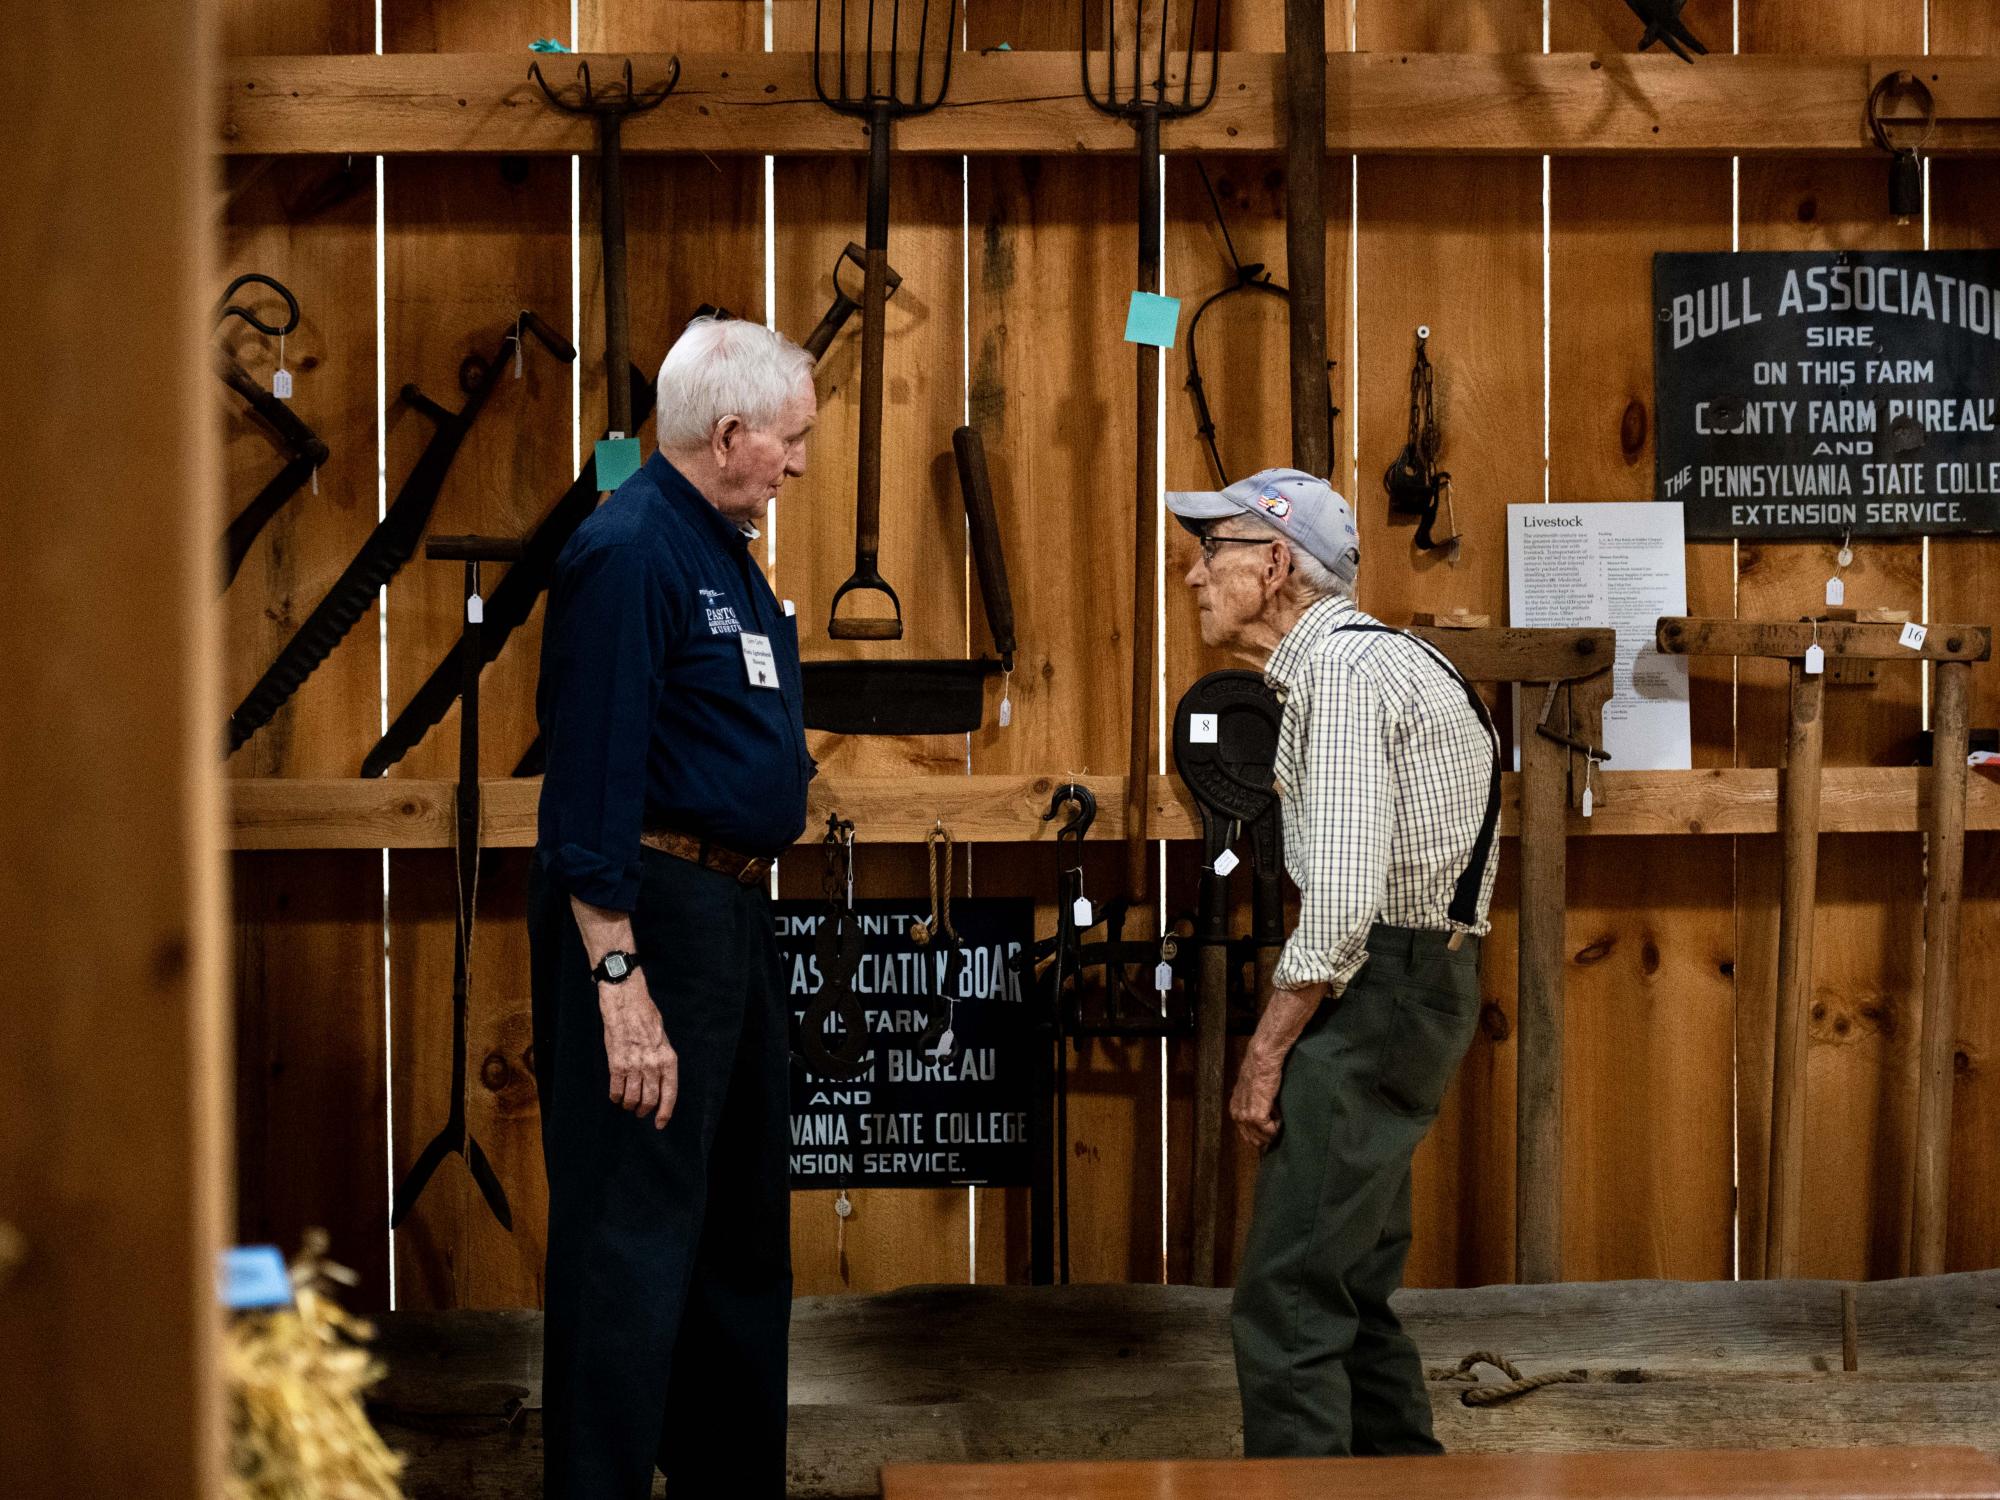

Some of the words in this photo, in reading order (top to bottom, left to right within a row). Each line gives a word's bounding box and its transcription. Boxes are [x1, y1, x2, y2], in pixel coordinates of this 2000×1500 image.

[1673, 277, 1762, 349] BULL
[1806, 326, 1874, 347] SIRE
[1754, 362, 1787, 385] ON
[1798, 361, 1855, 384] THIS
[1866, 360, 1934, 383] FARM
[1695, 401, 1797, 435] CNTY
[1808, 400, 1877, 433] FARM
[1812, 441, 1874, 455] AND
[1664, 465, 1692, 497] THE
[1700, 464, 1851, 497] PENNSYLVANIA
[1862, 463, 1925, 495] STATE
[1936, 462, 2000, 494] COLLE
[1523, 515, 1583, 527] Livestock
[1732, 504, 1856, 526] EXTENSION
[1866, 502, 1967, 524] SERVICE.
[1906, 627, 1922, 643] 16
[1202, 719, 1210, 731] 8
[864, 1010, 929, 1033] FARM
[809, 1091, 871, 1105] AND
[860, 1113, 923, 1145] STATE
[936, 1112, 1028, 1144] COLLEGE
[863, 1152, 966, 1173] SERVICE.
